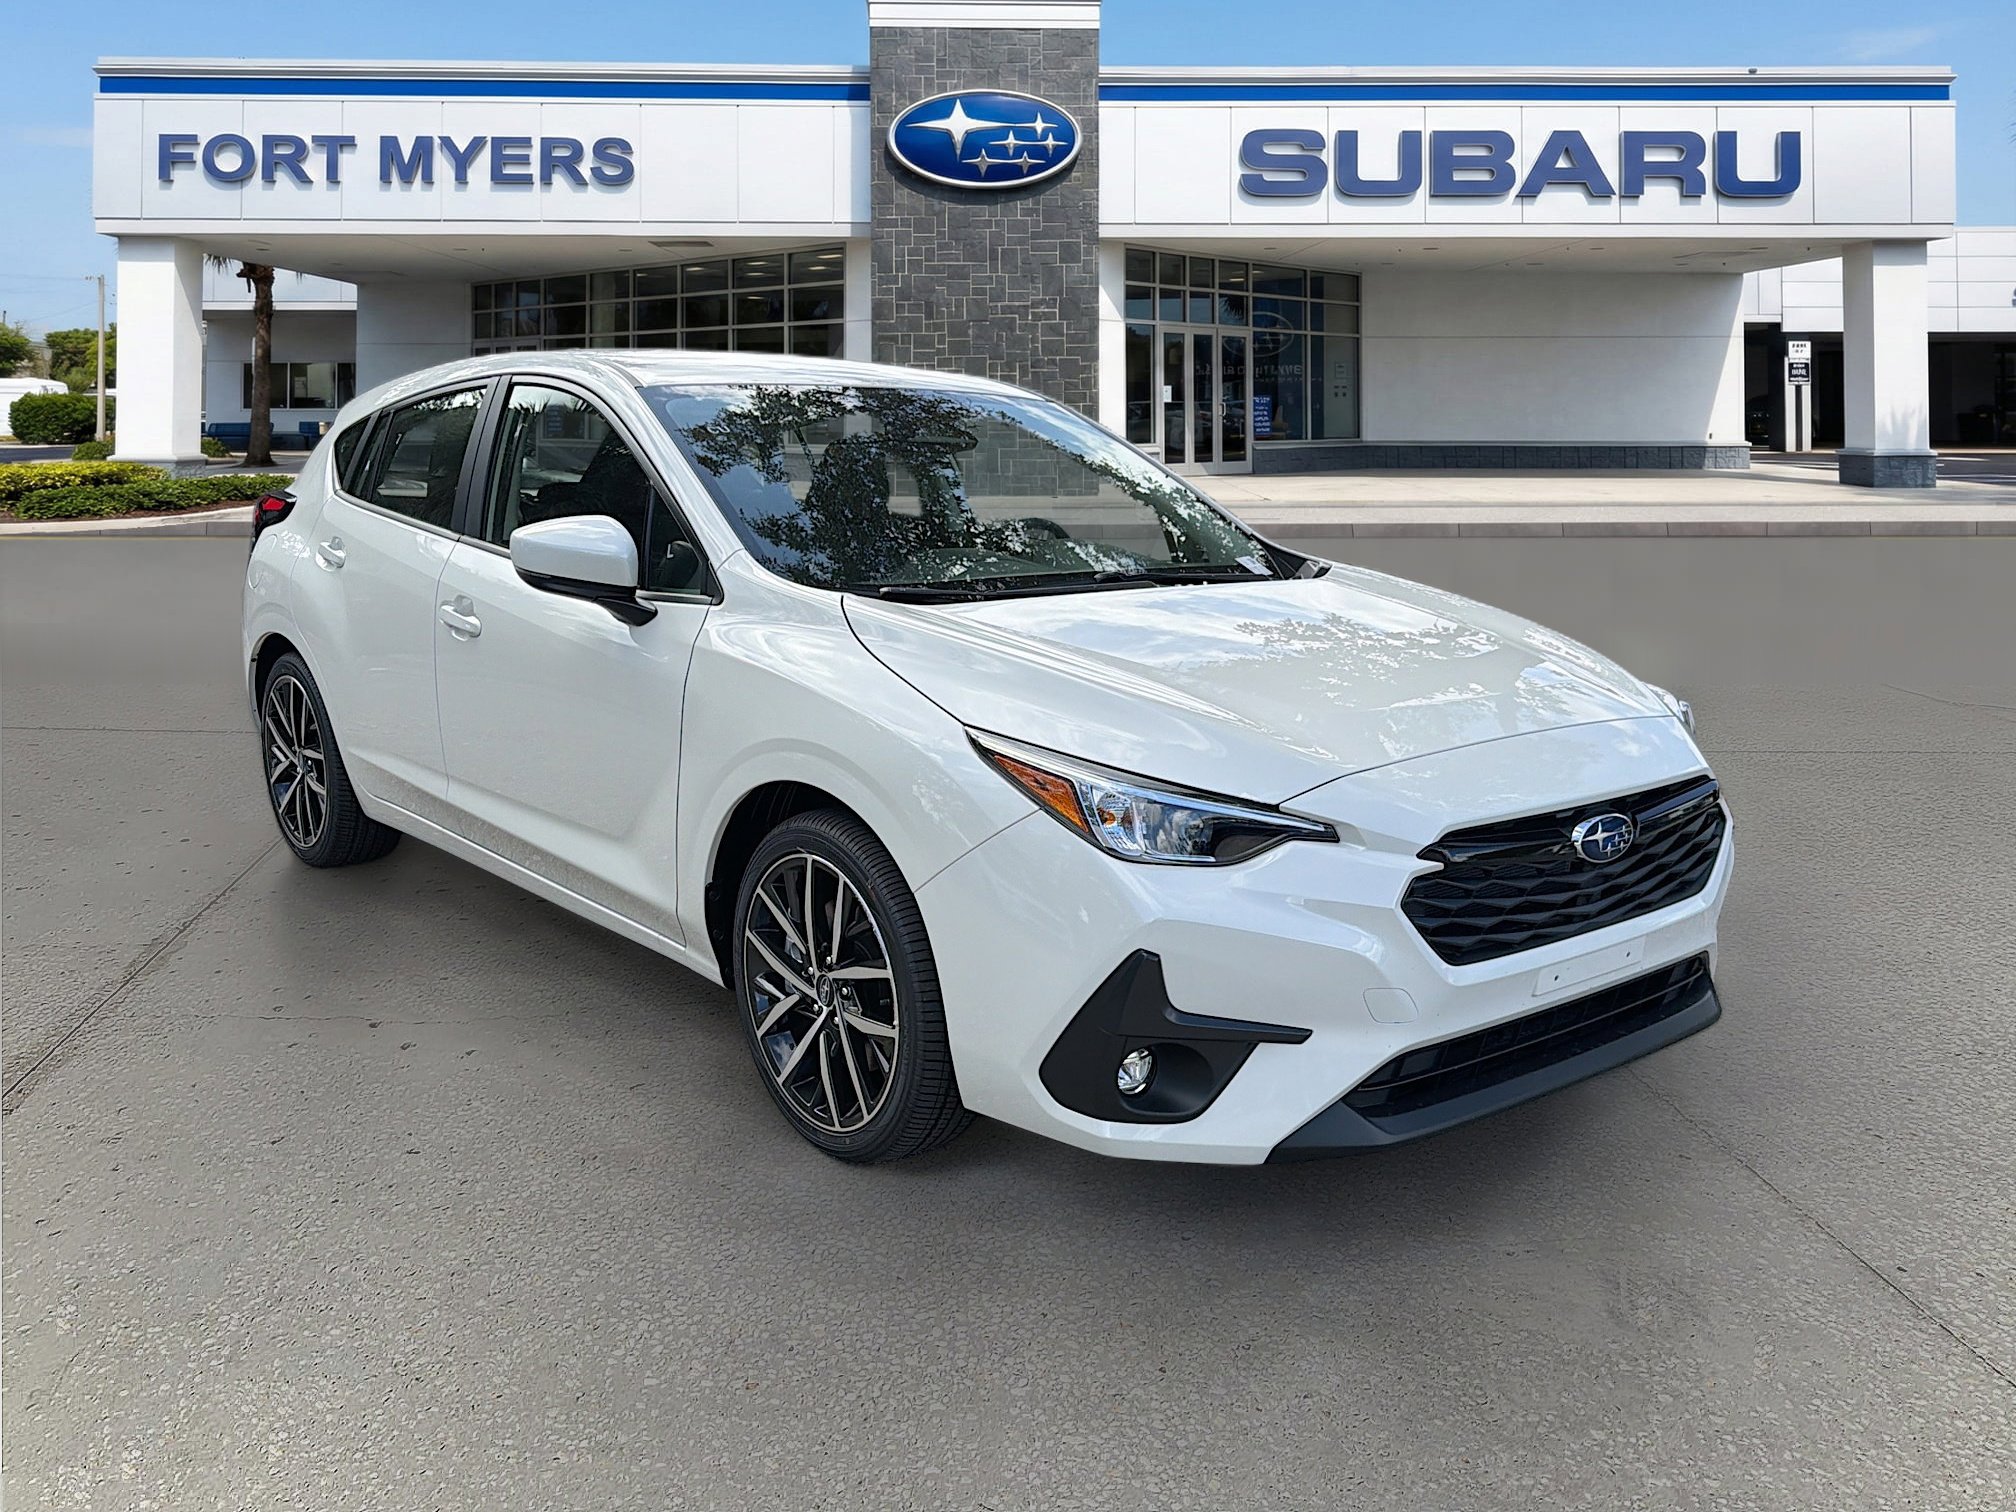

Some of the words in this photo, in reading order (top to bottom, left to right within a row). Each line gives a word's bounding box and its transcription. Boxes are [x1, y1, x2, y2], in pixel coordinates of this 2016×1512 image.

[157, 133, 357, 184] FORT
[378, 135, 635, 186] MYERS
[1239, 128, 1803, 199] SUBARU
